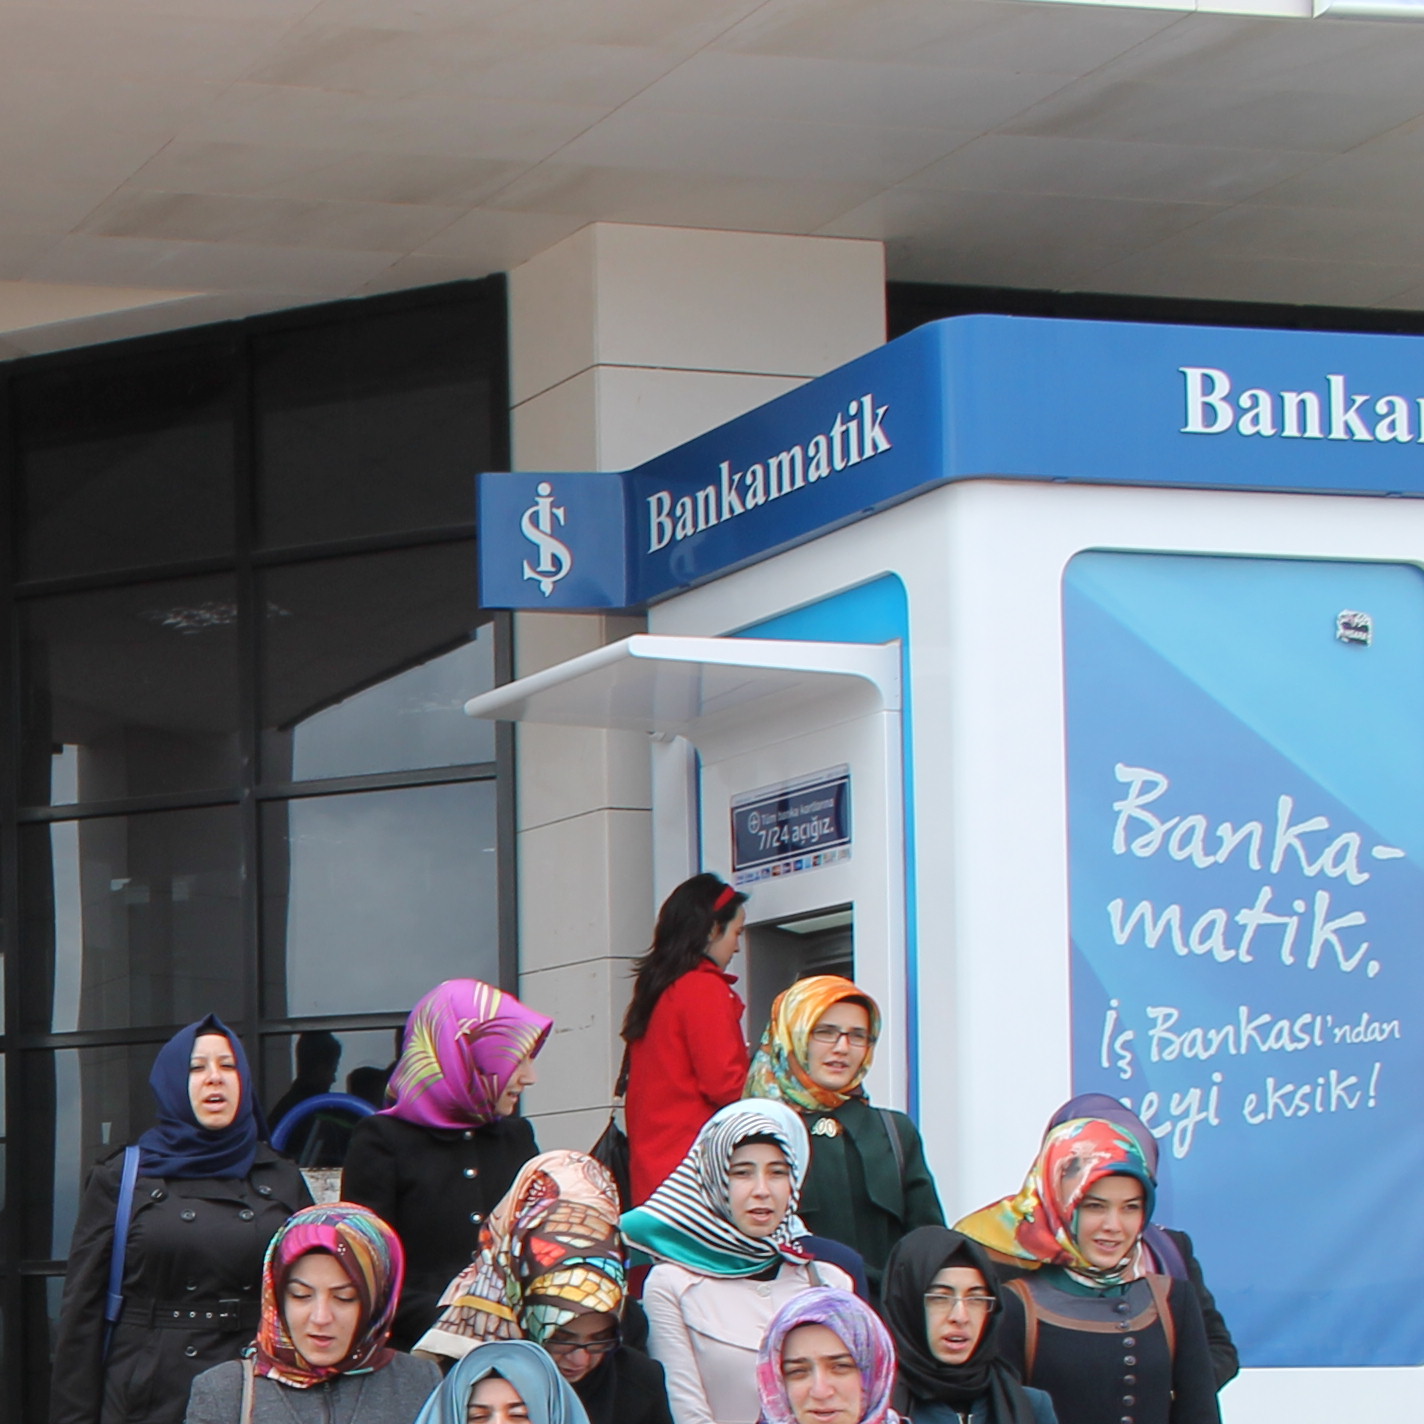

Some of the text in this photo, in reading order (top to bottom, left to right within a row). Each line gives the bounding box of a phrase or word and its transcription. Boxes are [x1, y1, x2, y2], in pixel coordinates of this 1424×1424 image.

[1178, 366, 1424, 444] Banka
[646, 393, 893, 555] Bankamatik
[758, 824, 790, 851] 7/24
[1112, 762, 1405, 886] Banka-
[1107, 885, 1380, 978] matik.
[1101, 998, 1135, 1080] İş
[1242, 1062, 1382, 1125] eksik!
